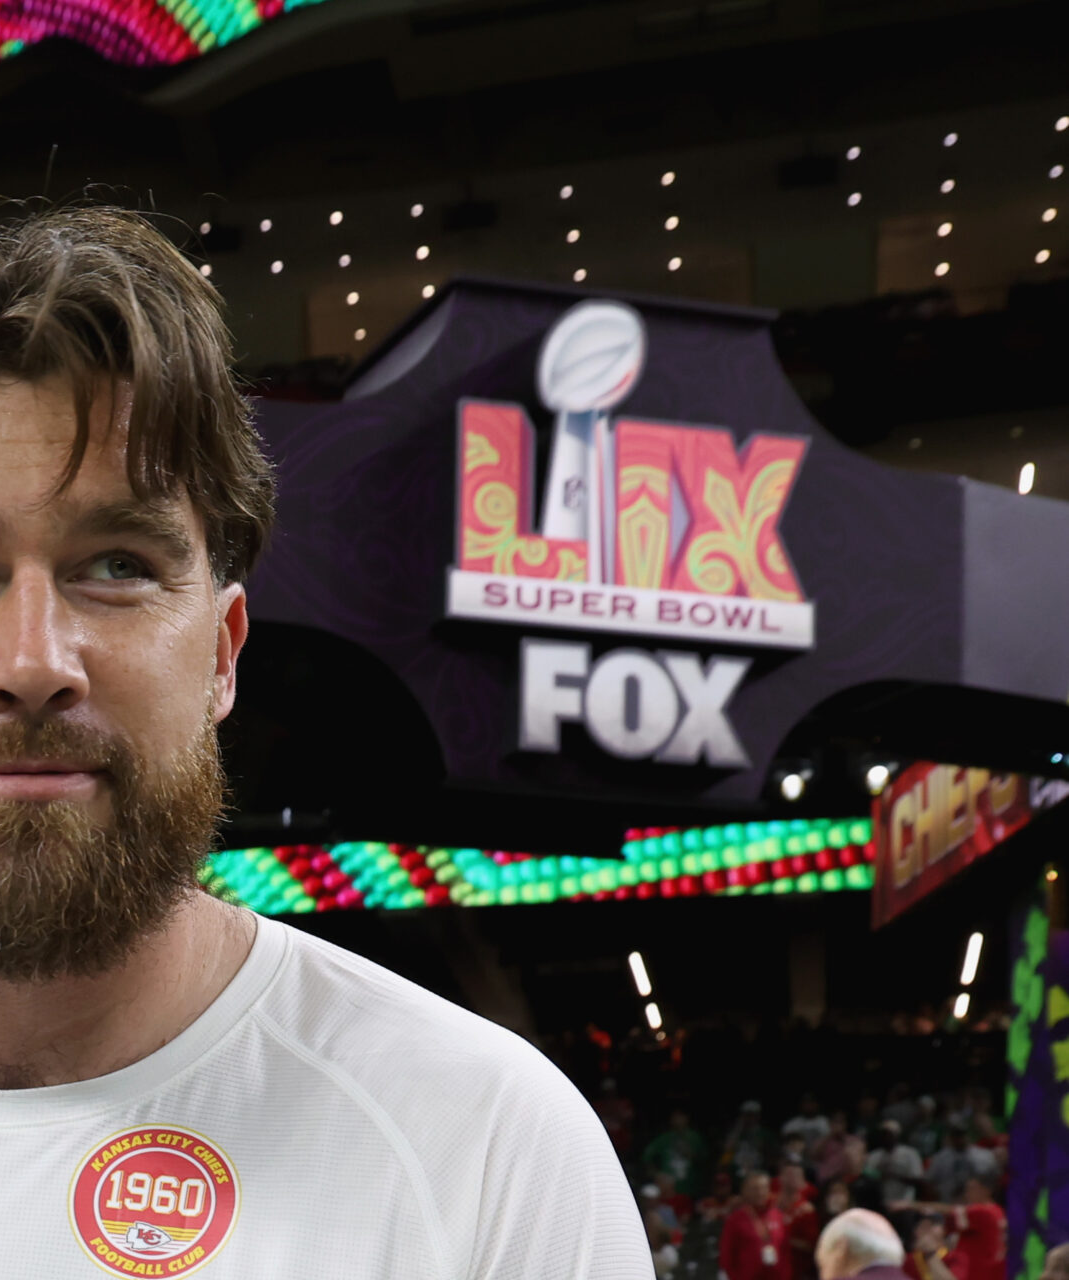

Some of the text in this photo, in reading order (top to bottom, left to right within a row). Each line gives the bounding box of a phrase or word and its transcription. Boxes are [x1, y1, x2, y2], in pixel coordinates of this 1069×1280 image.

[458, 400, 811, 604] LIX
[483, 582, 783, 634] SUPER BOWL
[519, 637, 753, 768] FOX
[91, 1133, 229, 1185] KANSAS CITY CHIEFS
[105, 1170, 208, 1217] 1960
[90, 1237, 206, 1276] FOOTBALL CLUB
